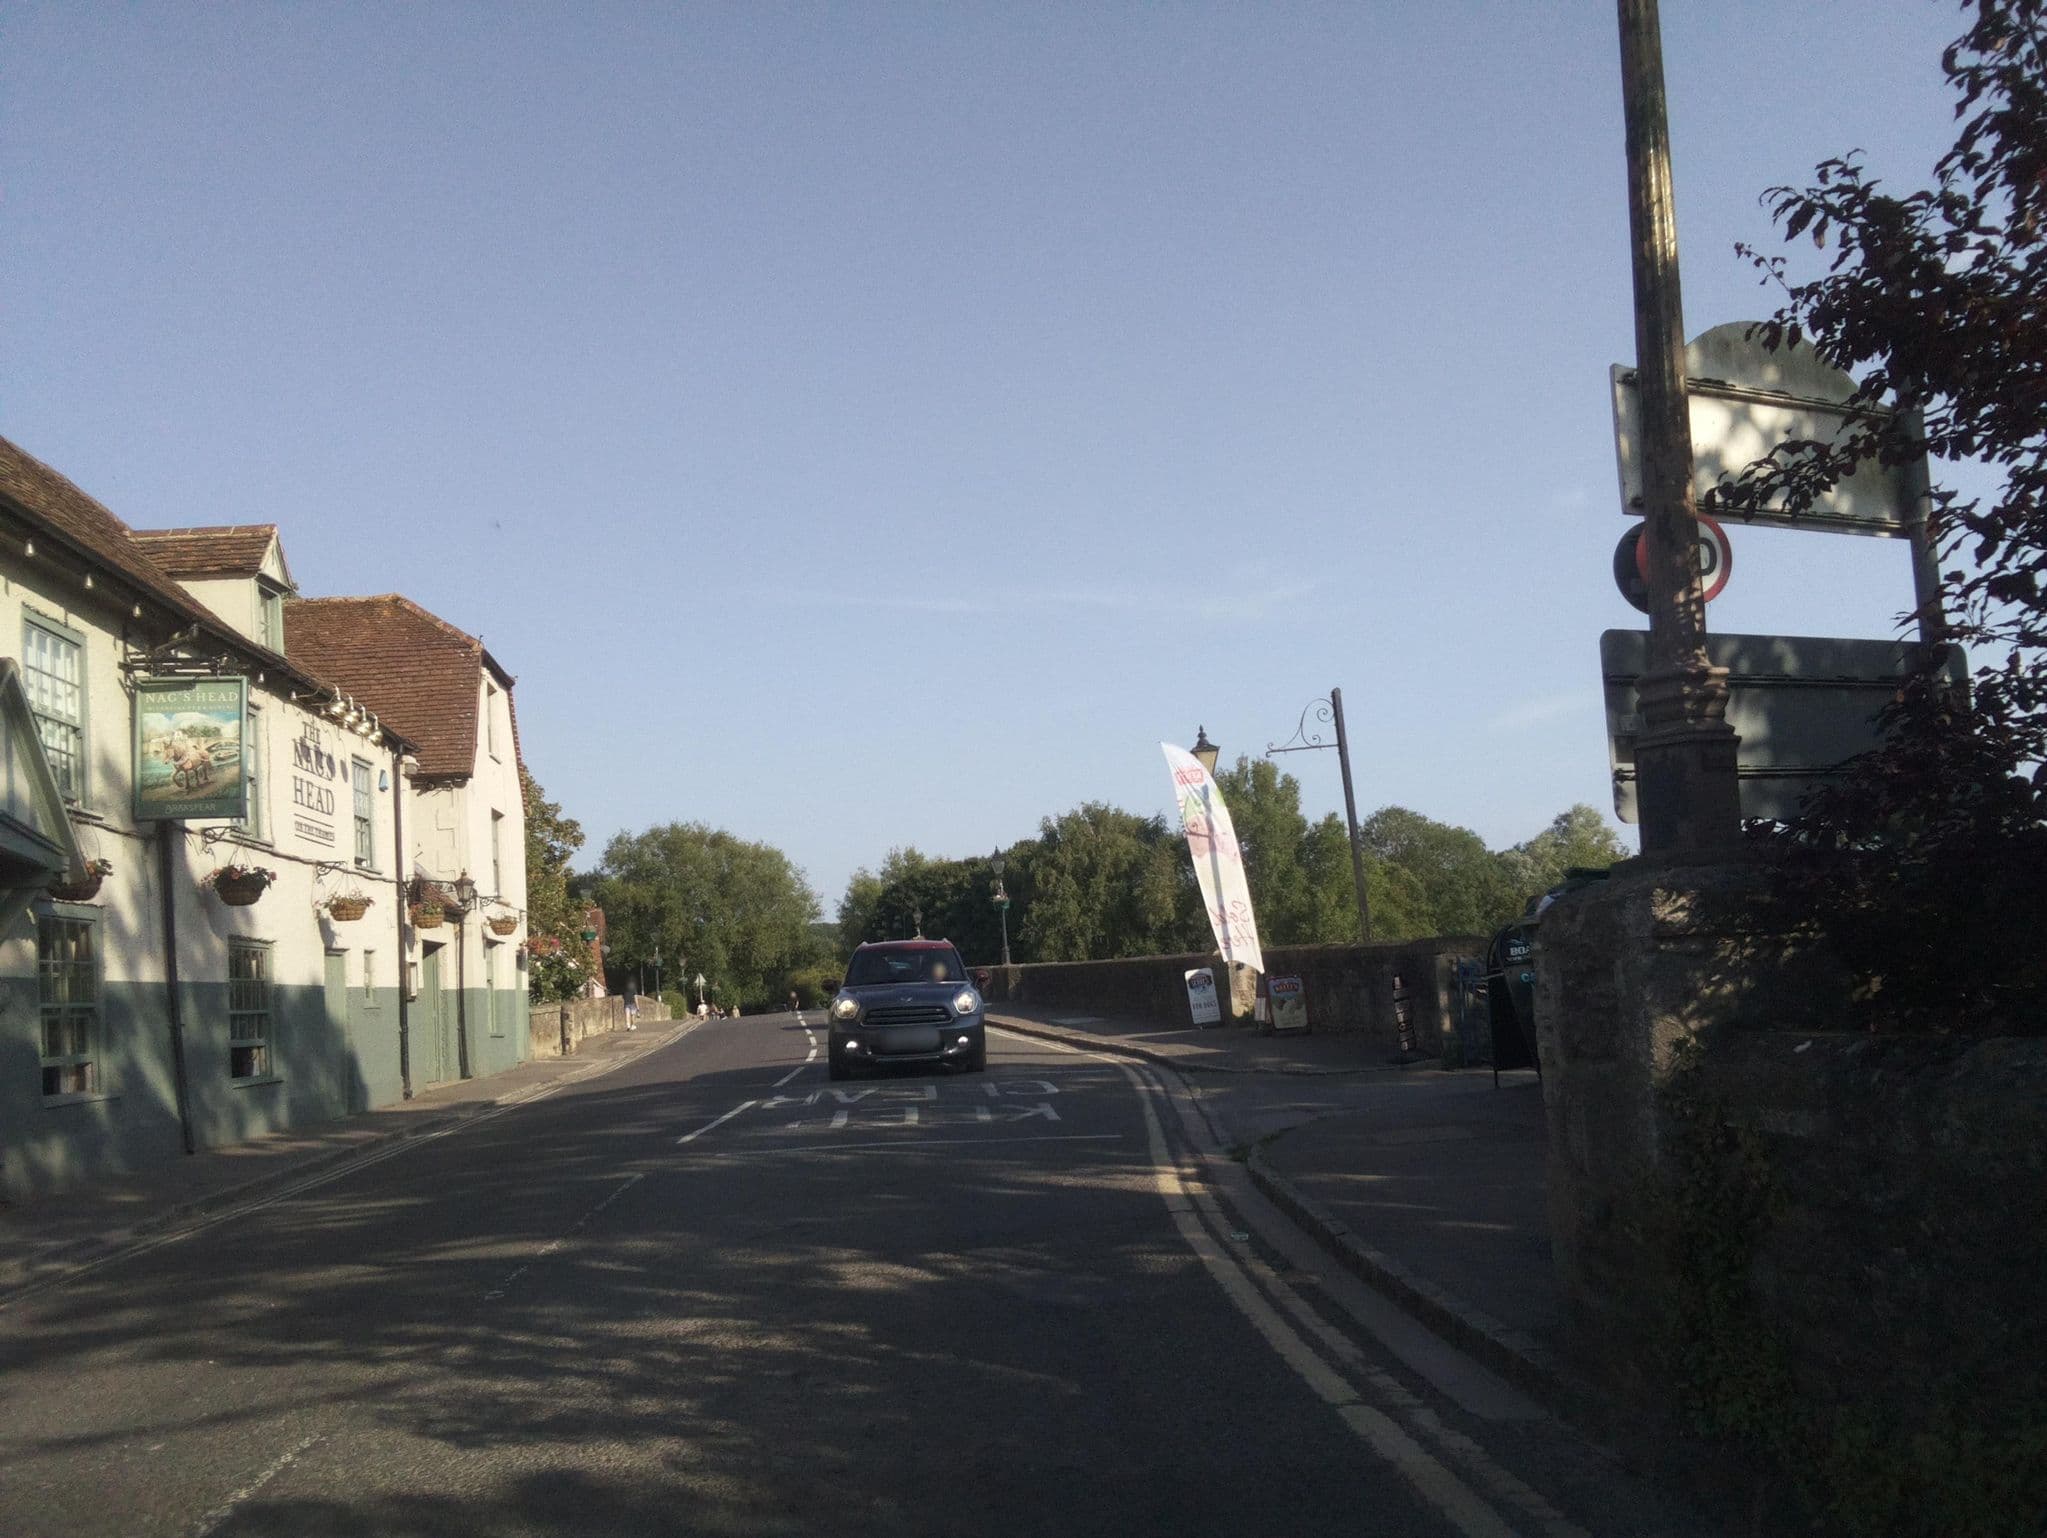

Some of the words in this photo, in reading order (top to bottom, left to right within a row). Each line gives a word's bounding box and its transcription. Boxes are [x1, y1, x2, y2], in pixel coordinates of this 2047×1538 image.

[145, 691, 192, 704] NAG'S
[196, 690, 238, 703] HEAD
[302, 721, 321, 745] THE
[293, 775, 335, 816] HEAD
